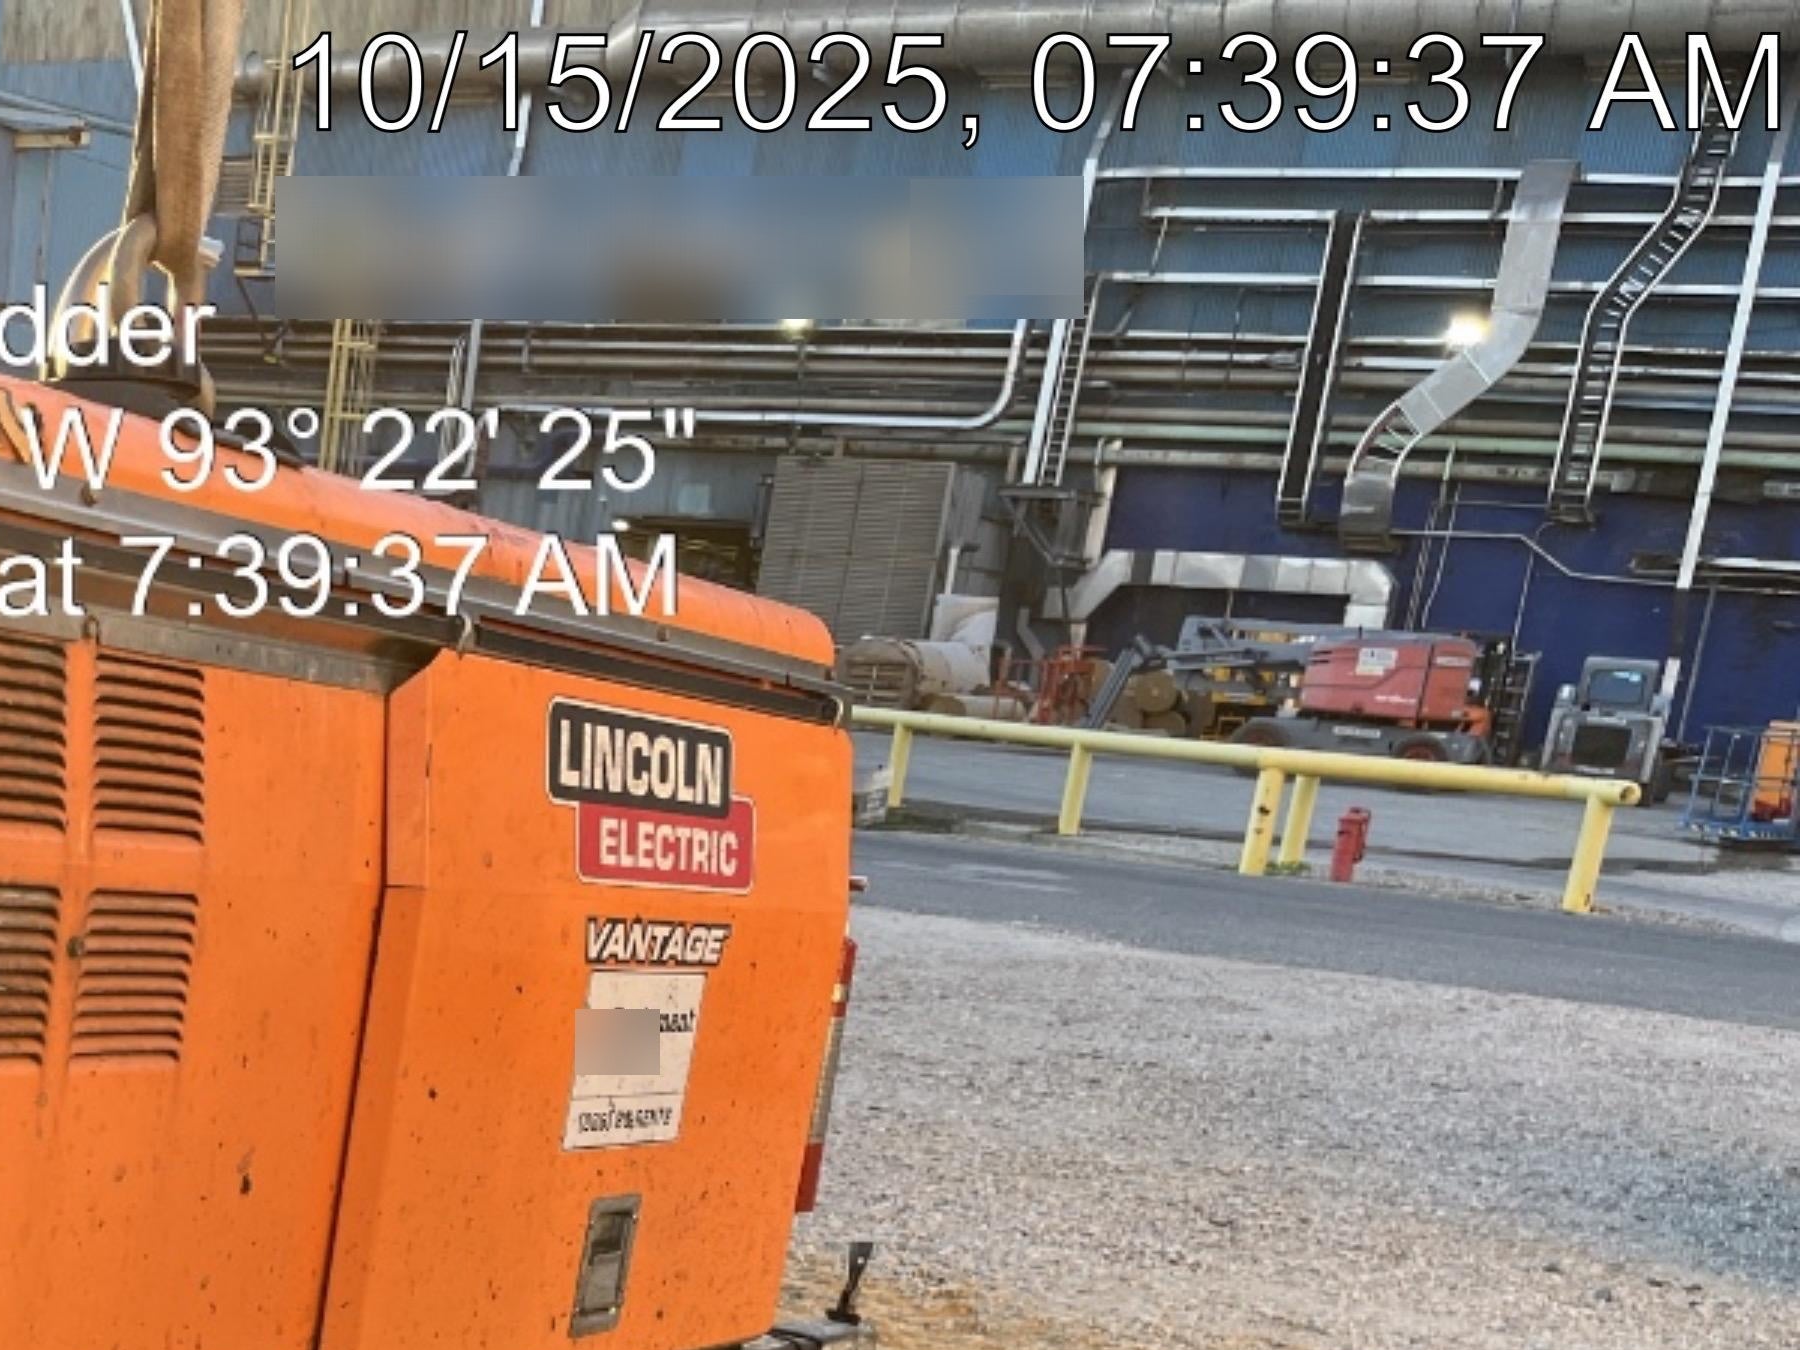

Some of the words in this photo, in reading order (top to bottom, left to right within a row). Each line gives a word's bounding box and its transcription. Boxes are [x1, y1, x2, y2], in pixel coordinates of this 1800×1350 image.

[559, 719, 725, 808] LINCOLN
[598, 816, 739, 878] ELECTRIC
[586, 917, 730, 967] VANTAGE
